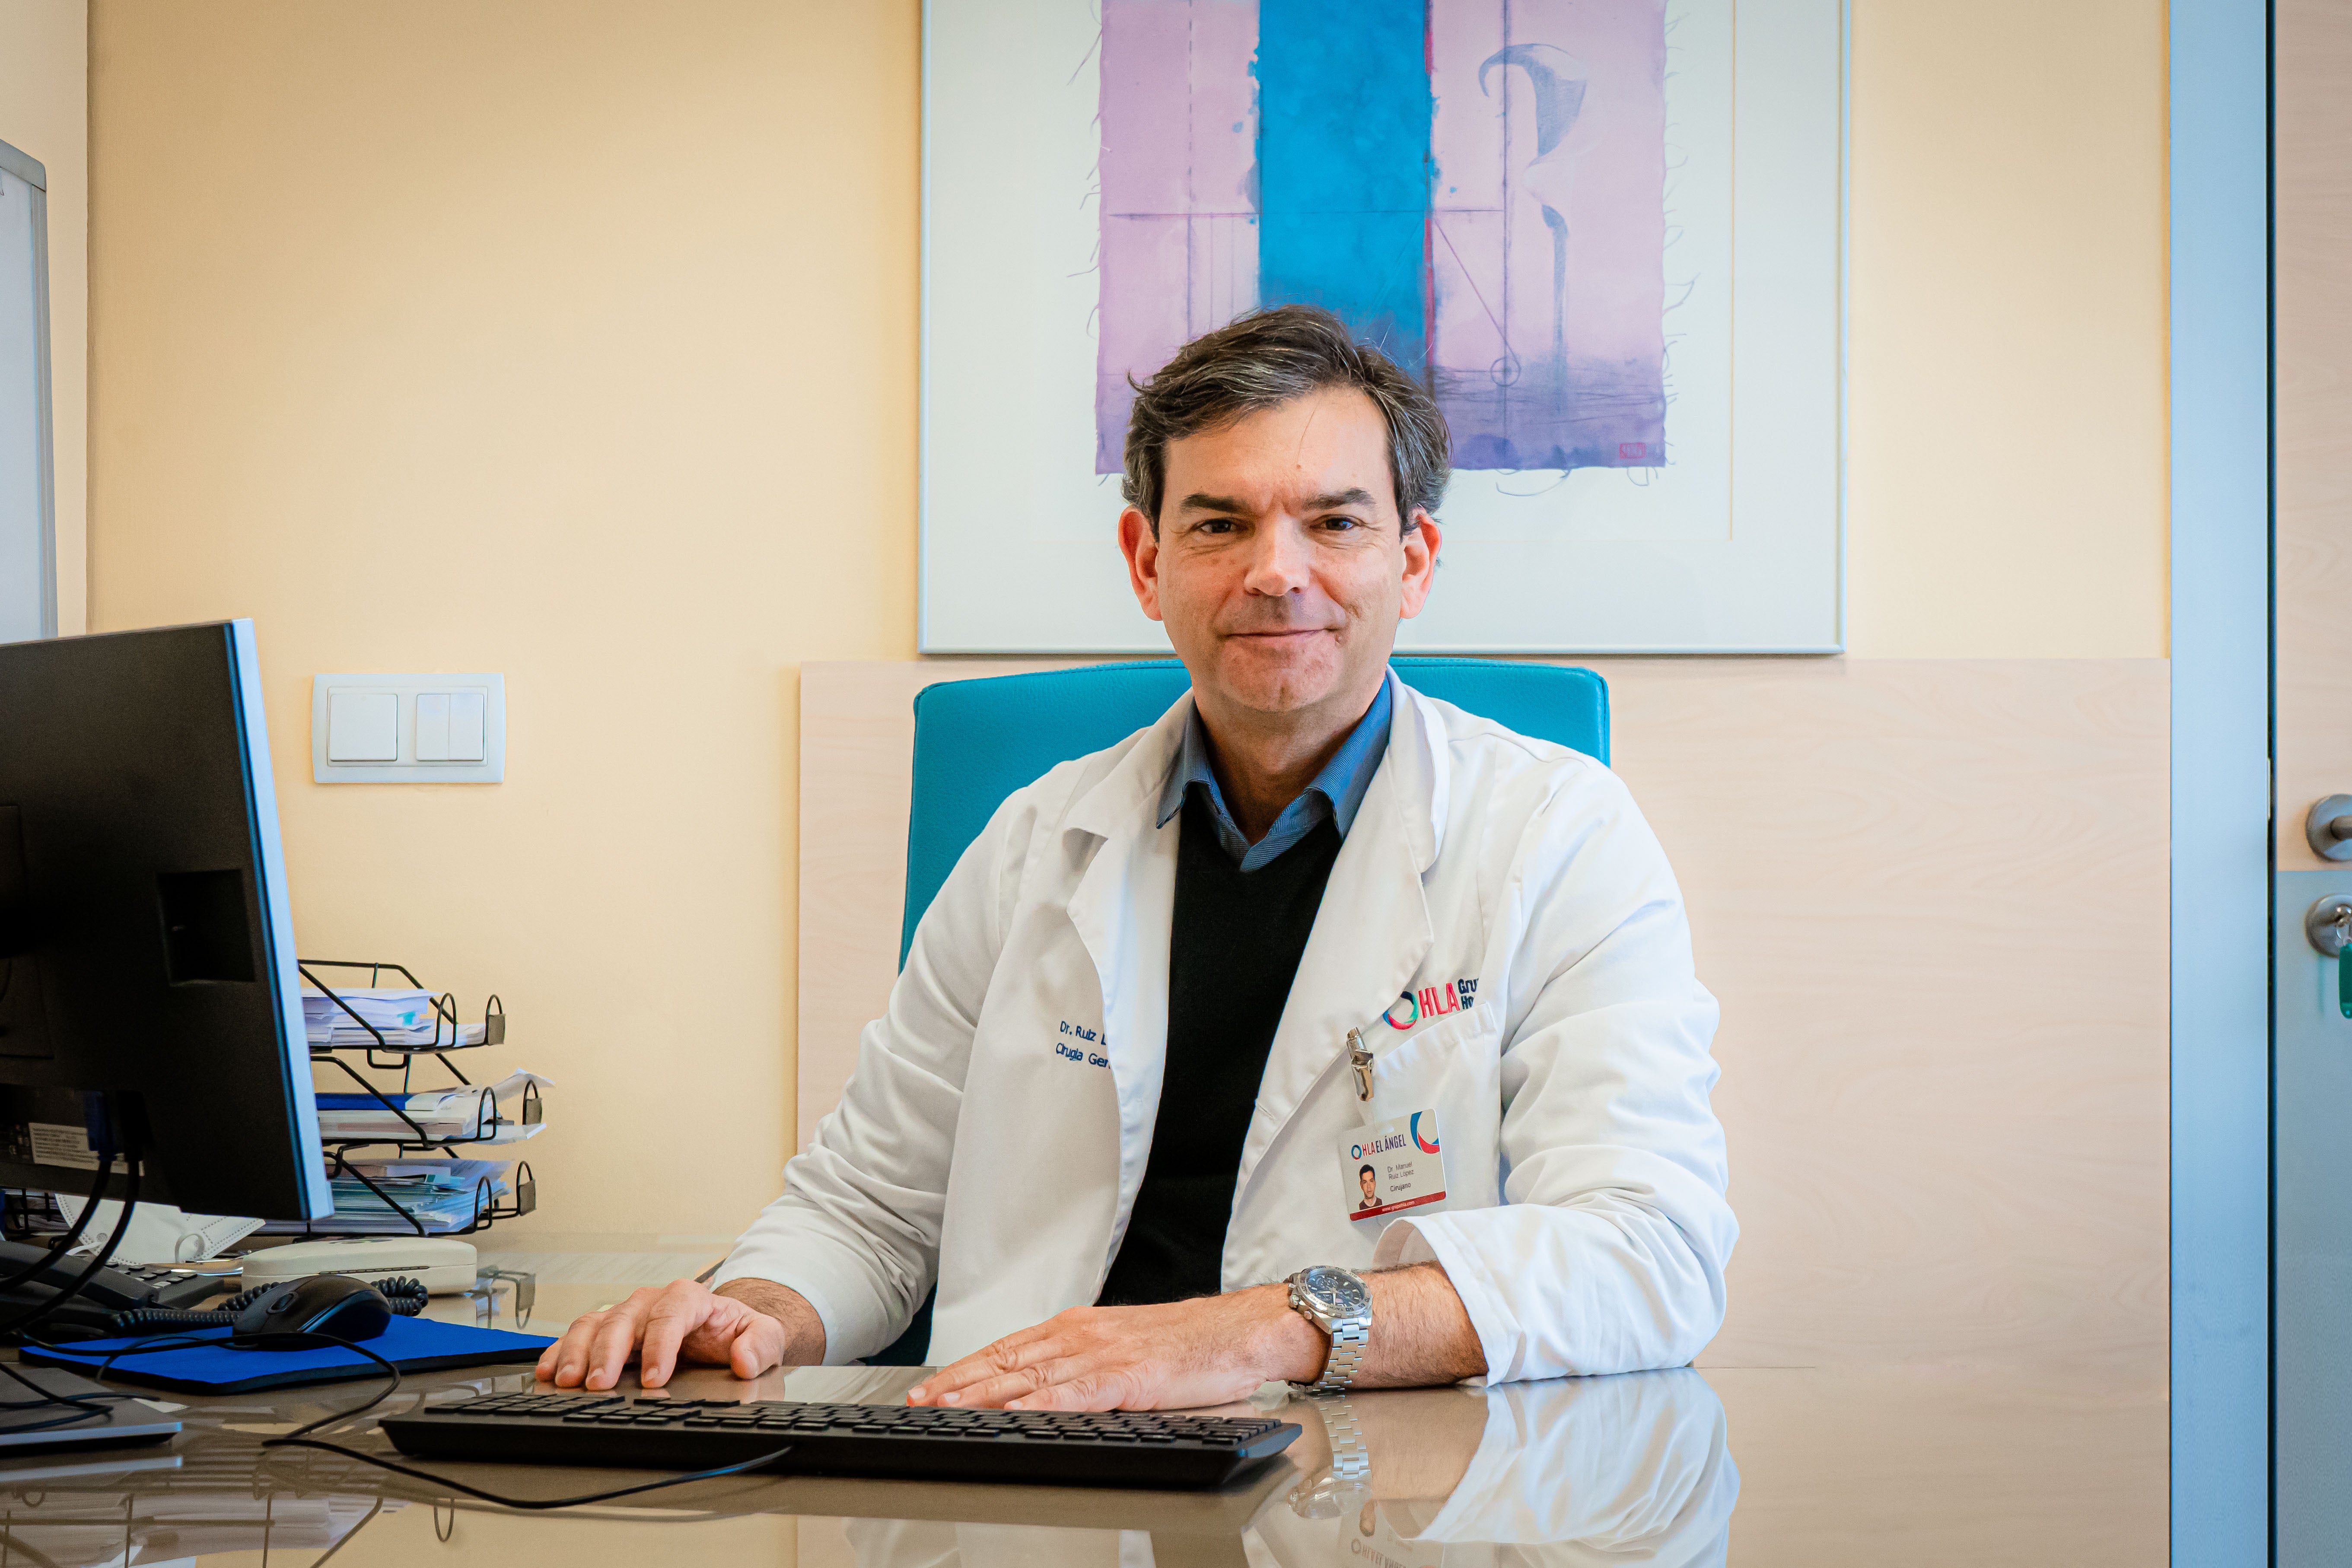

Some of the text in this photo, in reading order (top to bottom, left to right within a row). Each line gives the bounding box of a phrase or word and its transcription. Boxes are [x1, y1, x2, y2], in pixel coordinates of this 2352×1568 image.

[1458, 978, 1479, 994] Gru
[1418, 982, 1460, 1019] HLA
[1060, 1021, 1072, 1035] Dr.
[1362, 1134, 1407, 1157] HLA EL ÁNGEL
[1396, 1161, 1412, 1170] Manuel
[1390, 1183, 1411, 1192] Cirujano
